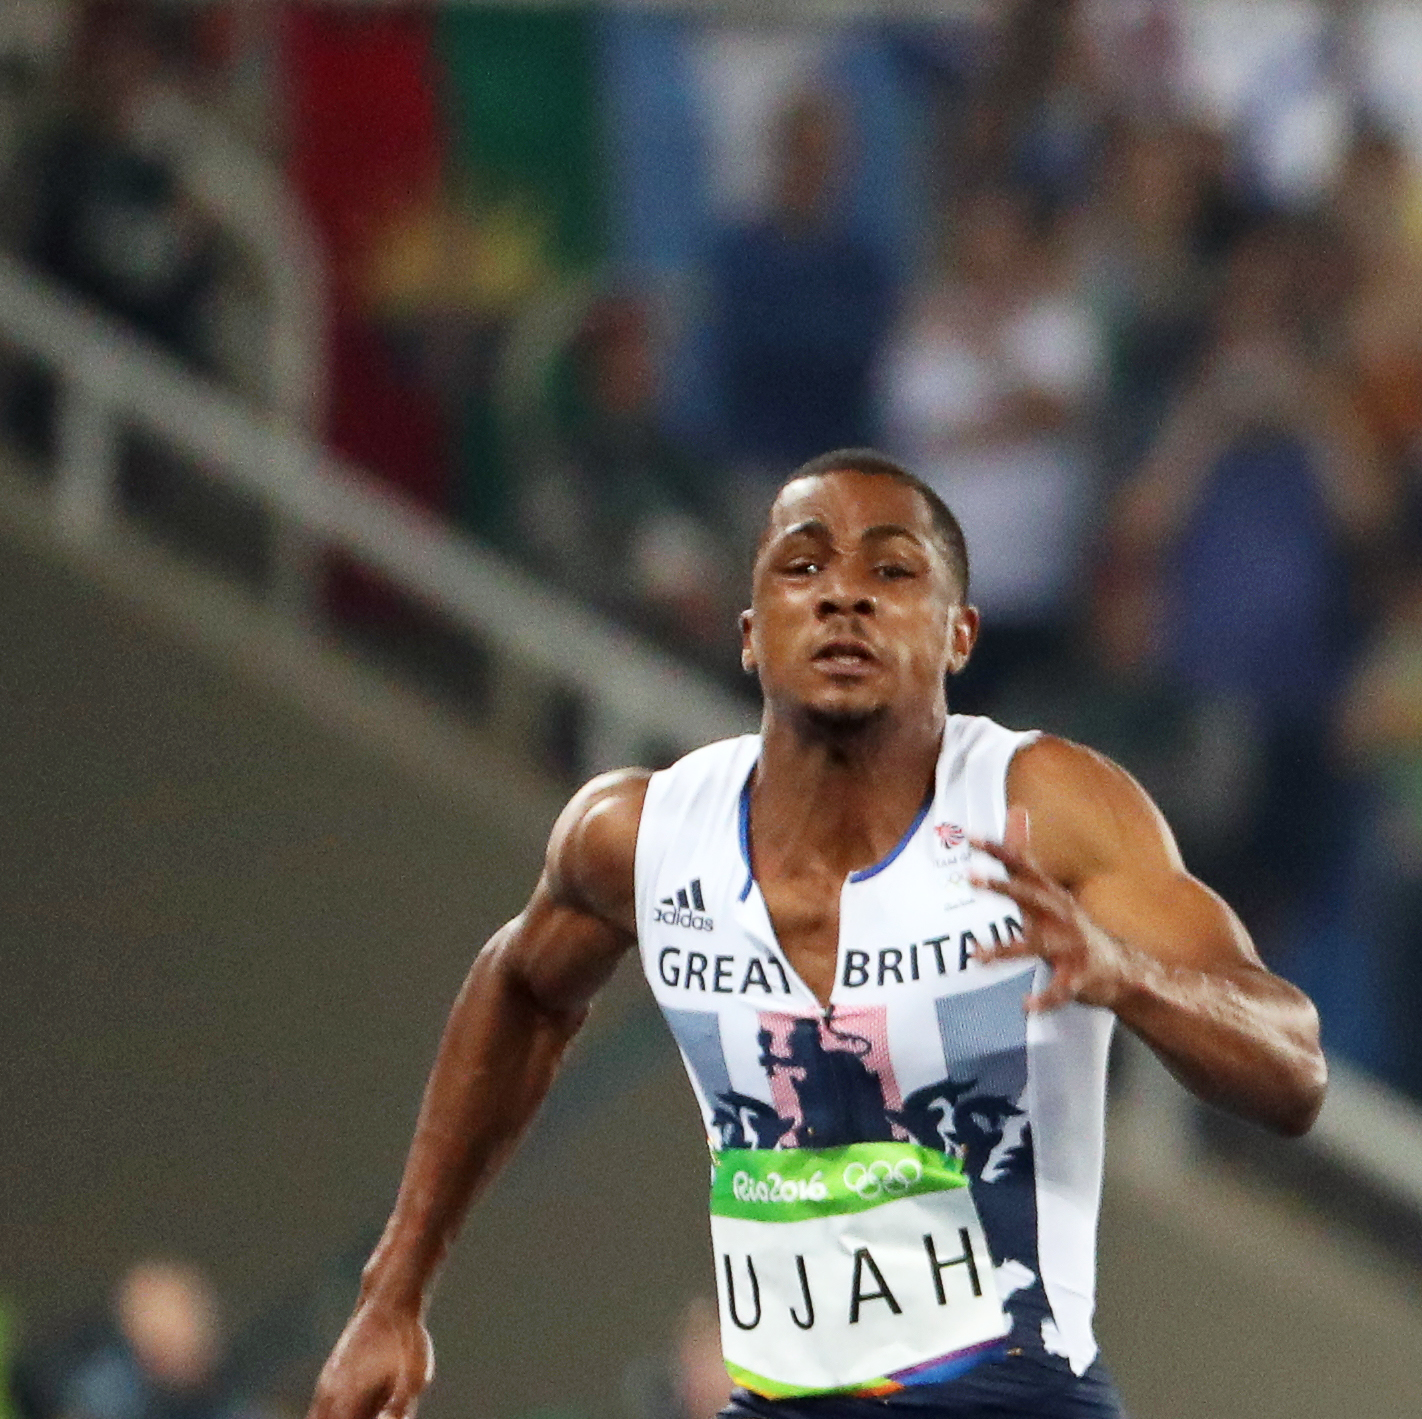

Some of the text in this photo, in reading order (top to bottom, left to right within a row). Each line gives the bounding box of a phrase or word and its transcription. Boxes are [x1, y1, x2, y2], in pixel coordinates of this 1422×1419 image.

[658, 946, 792, 995] GREAT
[732, 1170, 829, 1202] Rio2016
[723, 1226, 983, 1331] UJAH
